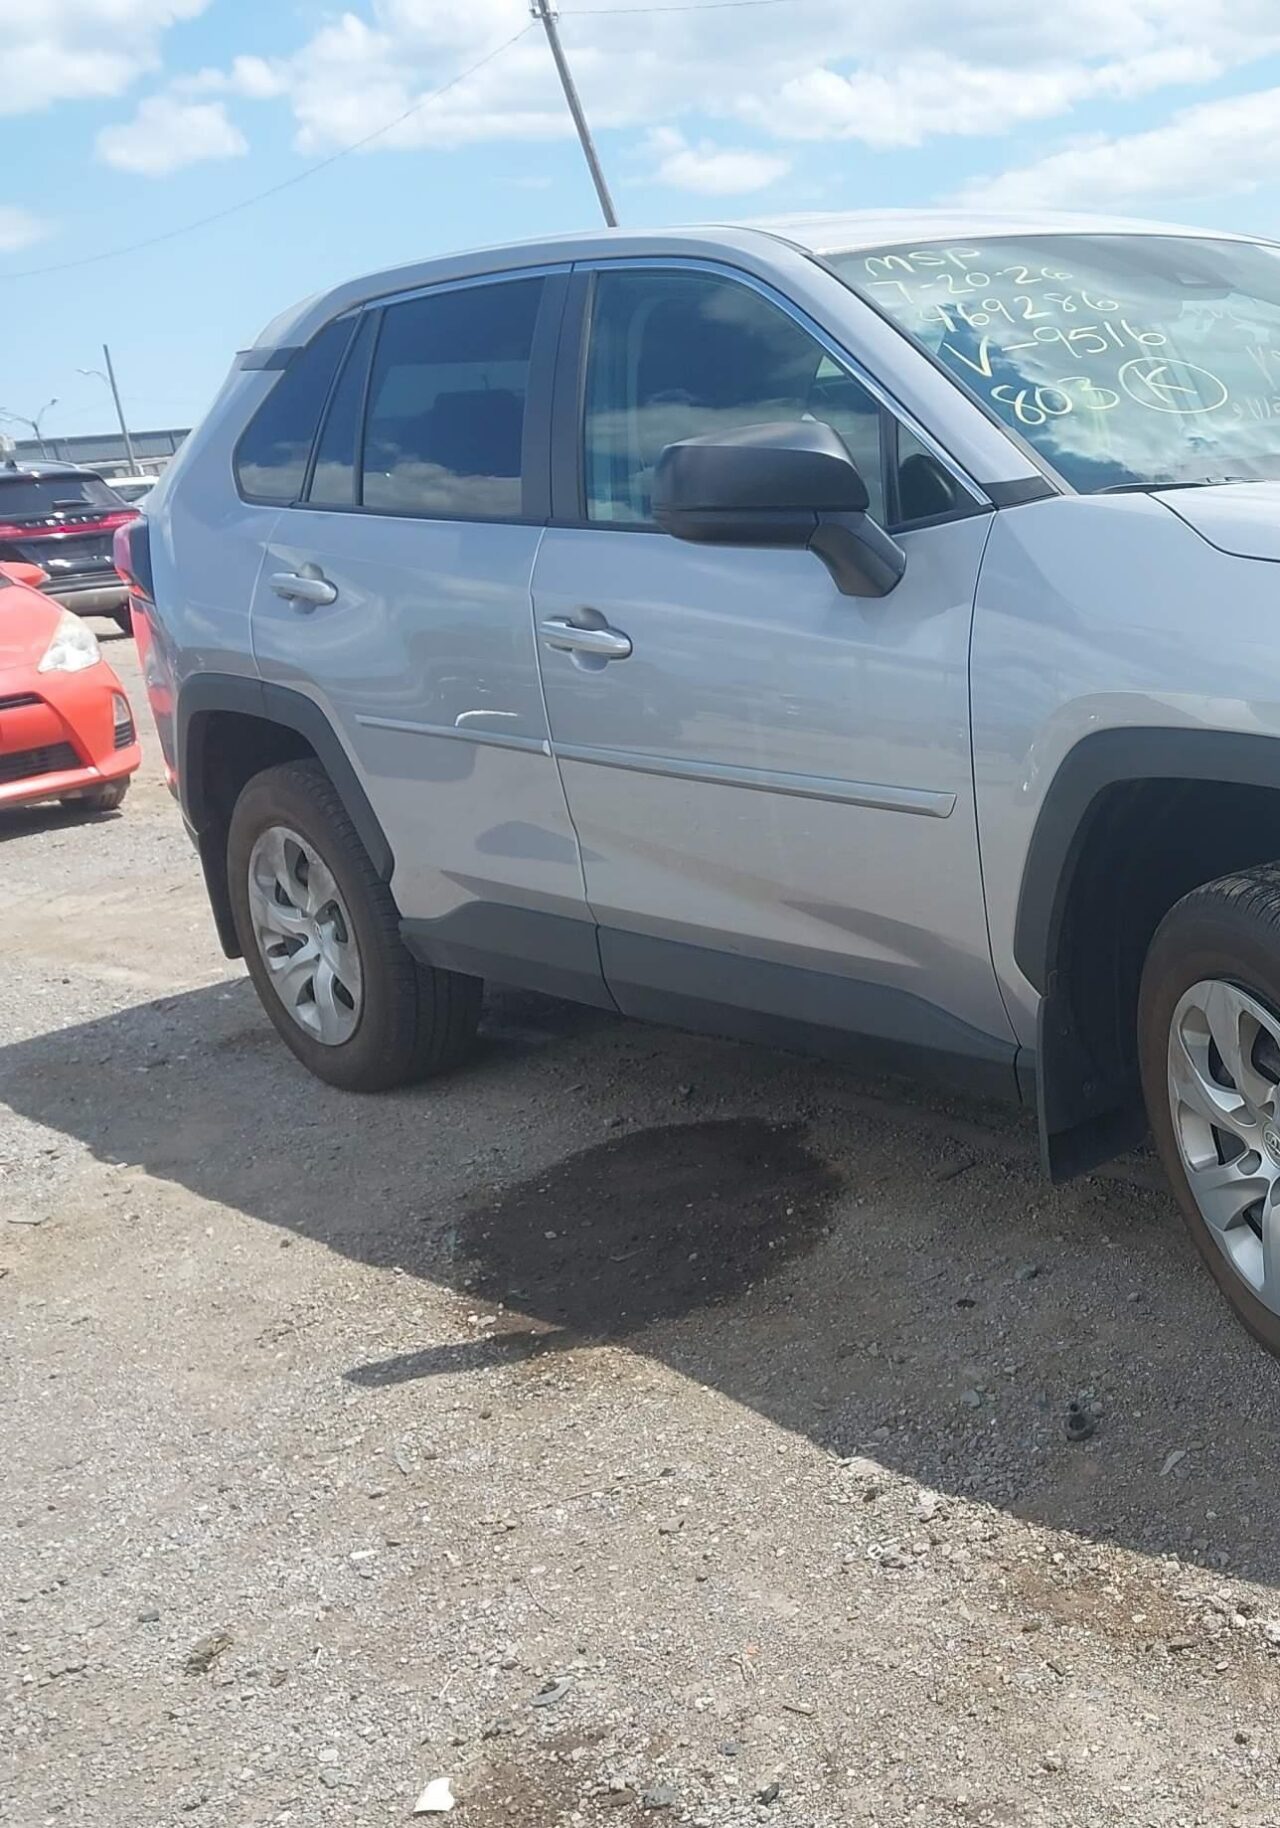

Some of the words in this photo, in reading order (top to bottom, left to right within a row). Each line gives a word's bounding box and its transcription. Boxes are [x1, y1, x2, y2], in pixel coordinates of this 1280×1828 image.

[864, 247, 981, 277] MSP
[866, 265, 1074, 305] 7-20-26
[919, 290, 1120, 333] 469286
[990, 376, 1121, 426] 803
